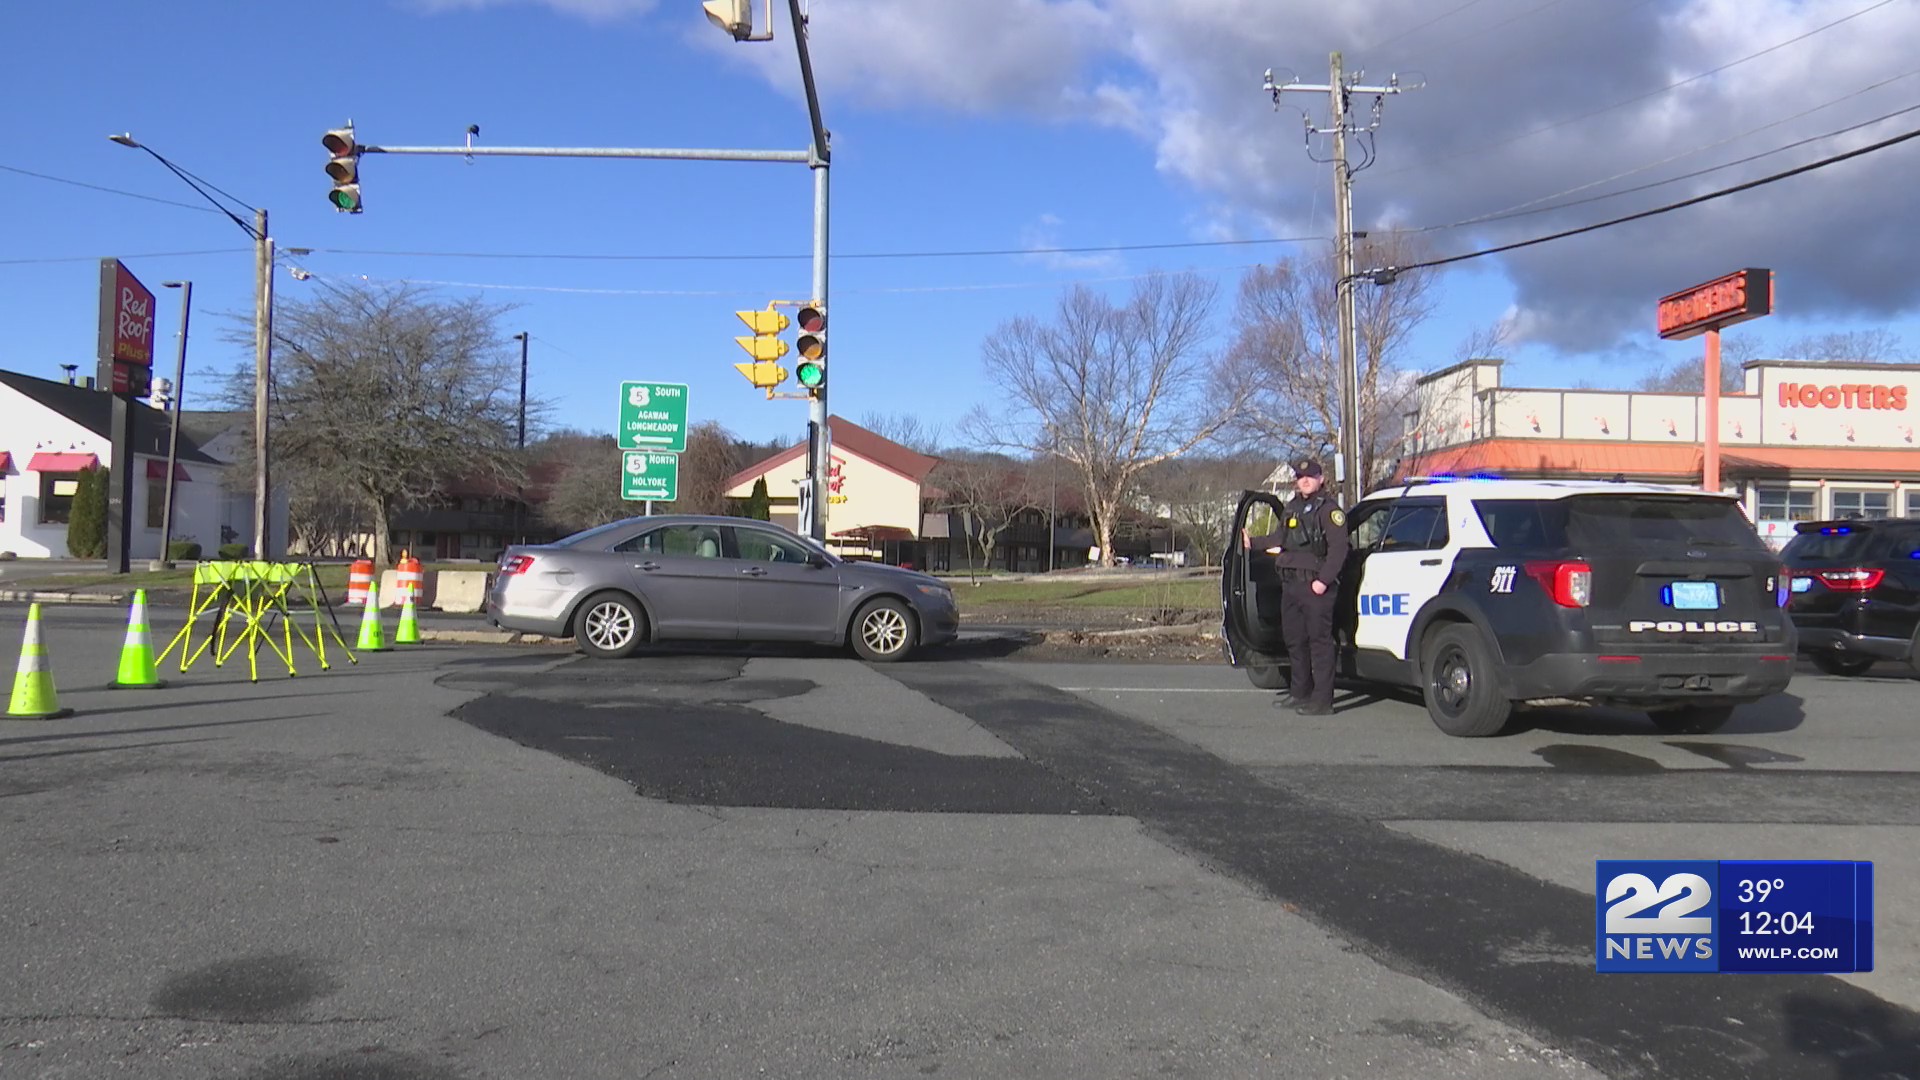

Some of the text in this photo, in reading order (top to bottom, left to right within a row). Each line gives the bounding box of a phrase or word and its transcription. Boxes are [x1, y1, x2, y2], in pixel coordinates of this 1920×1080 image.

[122, 286, 148, 317] Red
[1659, 276, 1747, 332] HOOTERS
[119, 311, 152, 344] Roof
[118, 342, 150, 360] Plus+
[636, 386, 681, 402] 5 SOUTH
[1778, 382, 1908, 411] HOOTERS
[637, 410, 669, 420] AGAWAM
[626, 421, 679, 432] LONGMEADOW
[633, 454, 675, 470] 5 NORTH
[632, 477, 667, 487] HOLYOKE
[1494, 565, 1517, 575] DIAL
[1489, 572, 1516, 593] 911
[1358, 593, 1410, 616] ICE
[1629, 621, 1758, 632] POLICE
